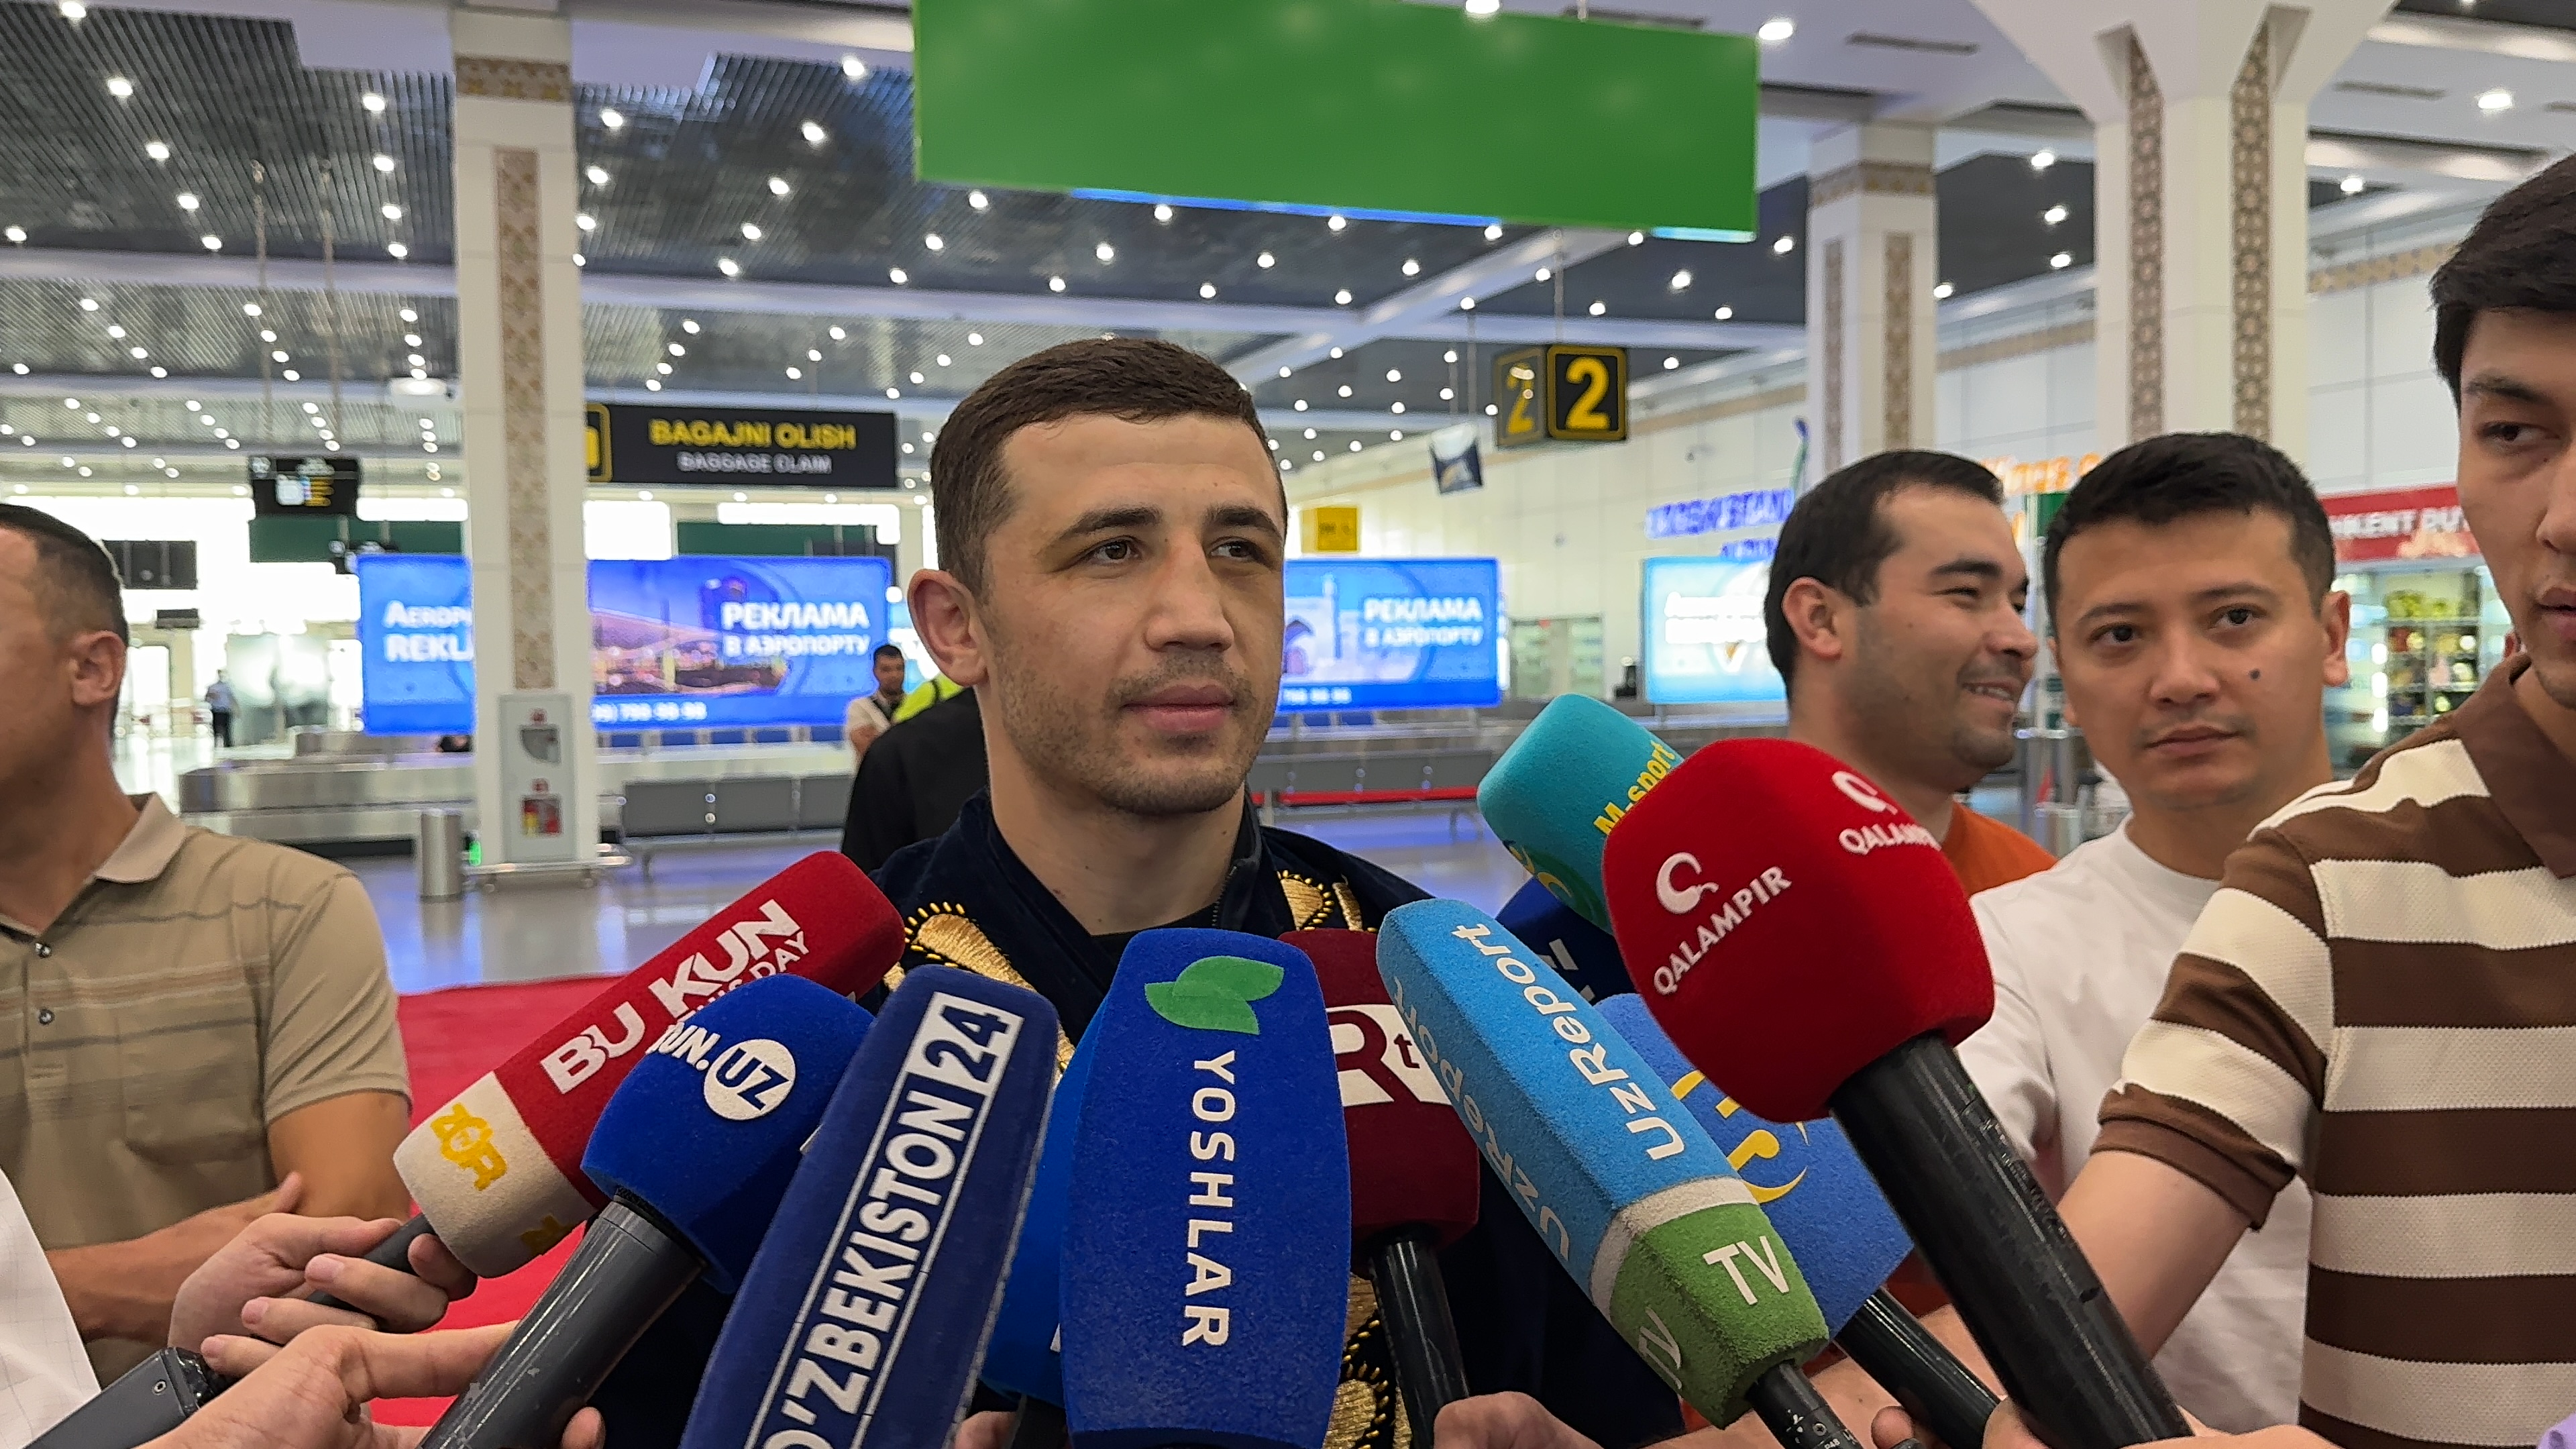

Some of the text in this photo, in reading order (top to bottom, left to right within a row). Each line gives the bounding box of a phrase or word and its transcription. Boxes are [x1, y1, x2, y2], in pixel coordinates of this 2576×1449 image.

[1565, 356, 1609, 431] 2
[649, 419, 857, 449] BAGAJNI OLISH
[677, 451, 832, 474] BAGGAGE CLAIM
[722, 602, 870, 630] РЕКЛАМА
[1364, 597, 1483, 623] РЕКЛАМА
[384, 633, 474, 662] REKL
[744, 635, 871, 656] АЭРОПОРТУ
[749, 930, 810, 979] DAY
[1654, 865, 1792, 996] QALAMPIR
[539, 1001, 645, 1095] BU
[647, 899, 801, 1018] KUN
[922, 1006, 1010, 1085] 24
[1181, 1049, 1238, 1347] YOSHLAR
[1703, 1236, 1790, 1305] TV
